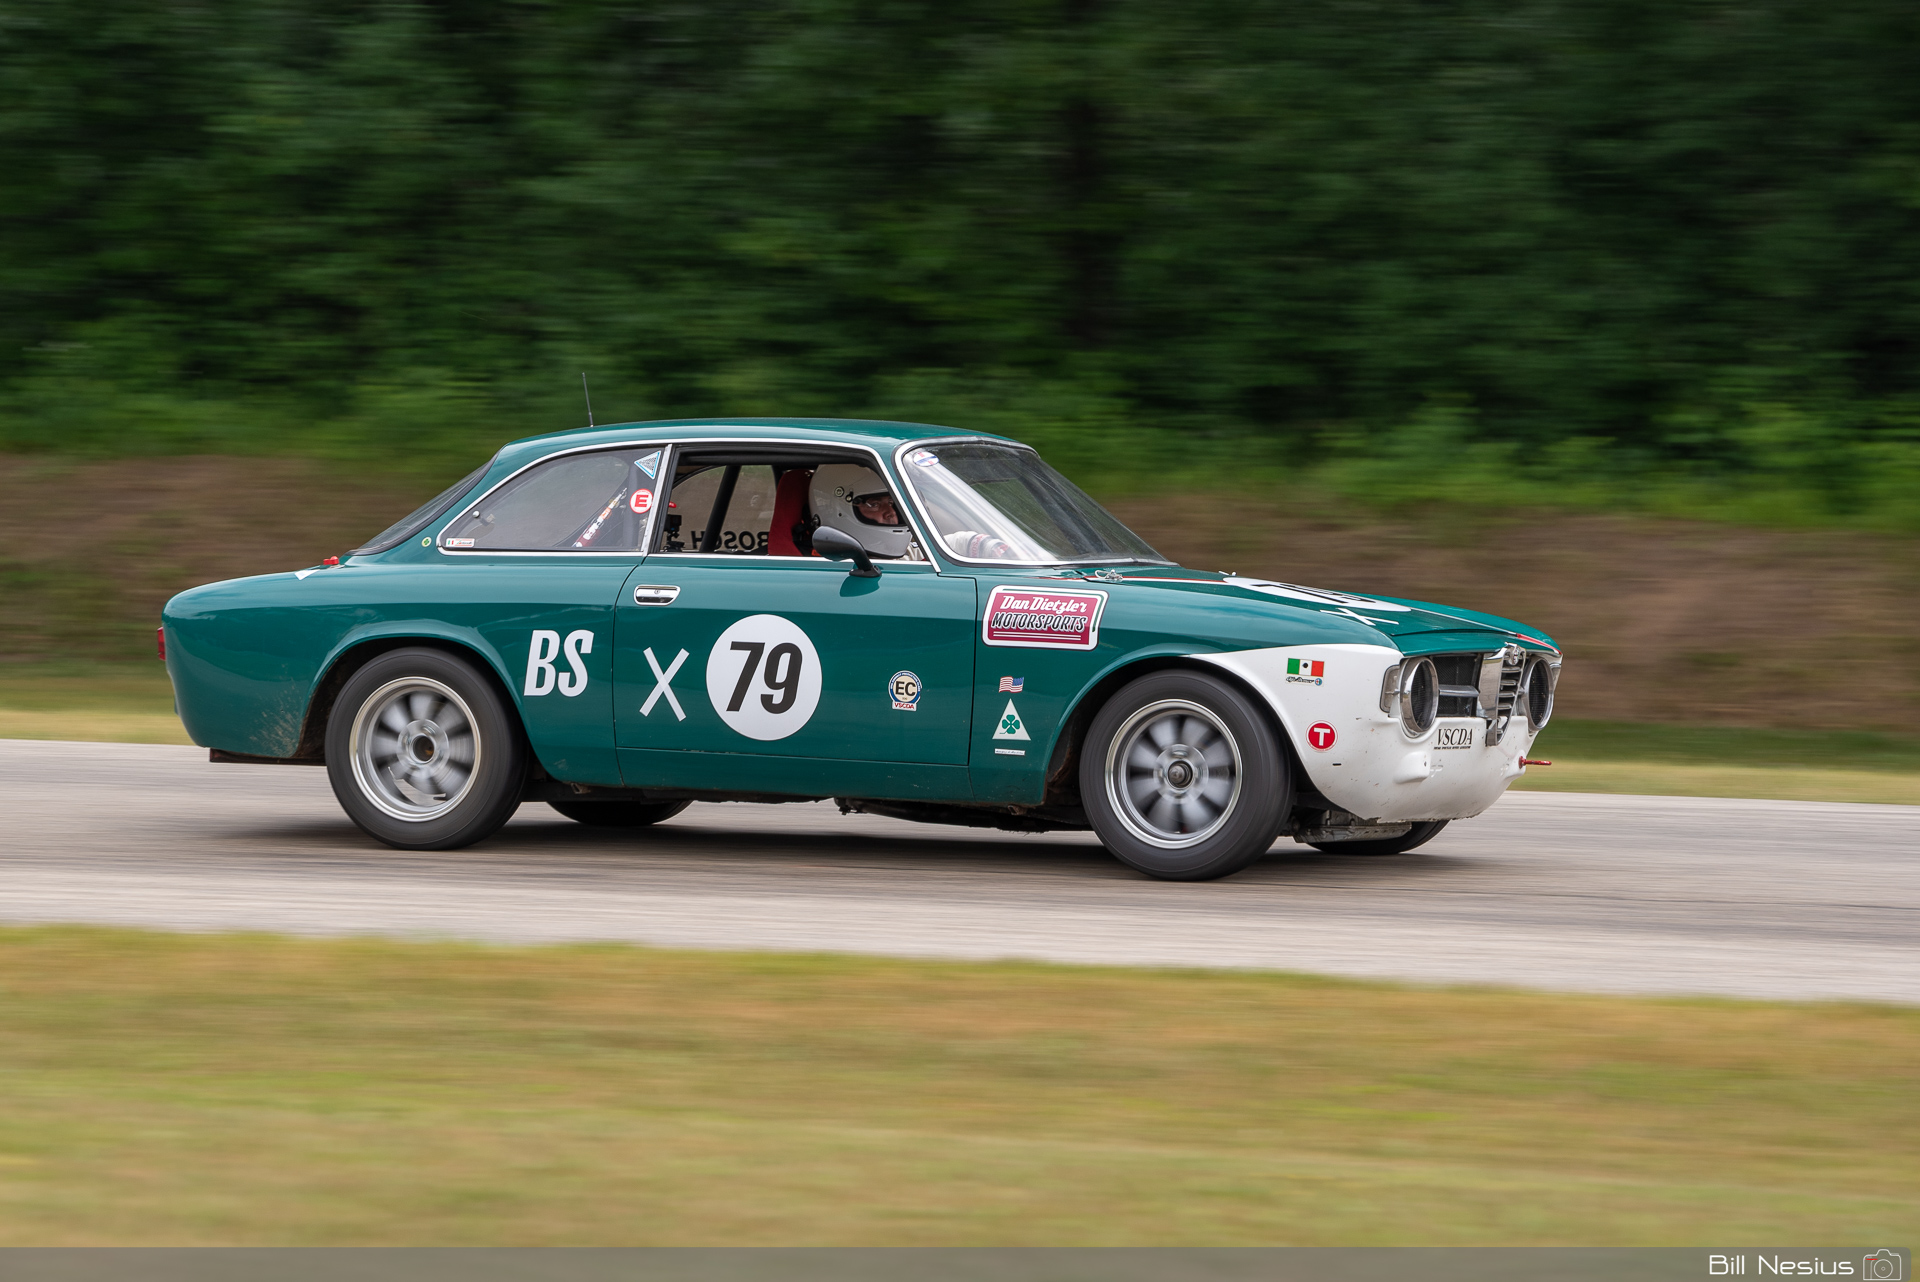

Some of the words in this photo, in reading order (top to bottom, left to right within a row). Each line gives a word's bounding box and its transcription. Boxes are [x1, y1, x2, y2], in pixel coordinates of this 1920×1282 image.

[634, 494, 649, 508] E
[1000, 595, 1030, 611] Dan
[1029, 596, 1087, 615] Dietzler
[991, 612, 1088, 633] MOTORSPORTS
[1320, 607, 1399, 626] X
[524, 629, 595, 697] BS
[639, 647, 690, 722] X
[726, 641, 803, 714] 79
[895, 681, 917, 697] EC
[894, 702, 915, 710] VSCDA
[1313, 727, 1331, 747] T
[1437, 728, 1473, 746] VSCDA
